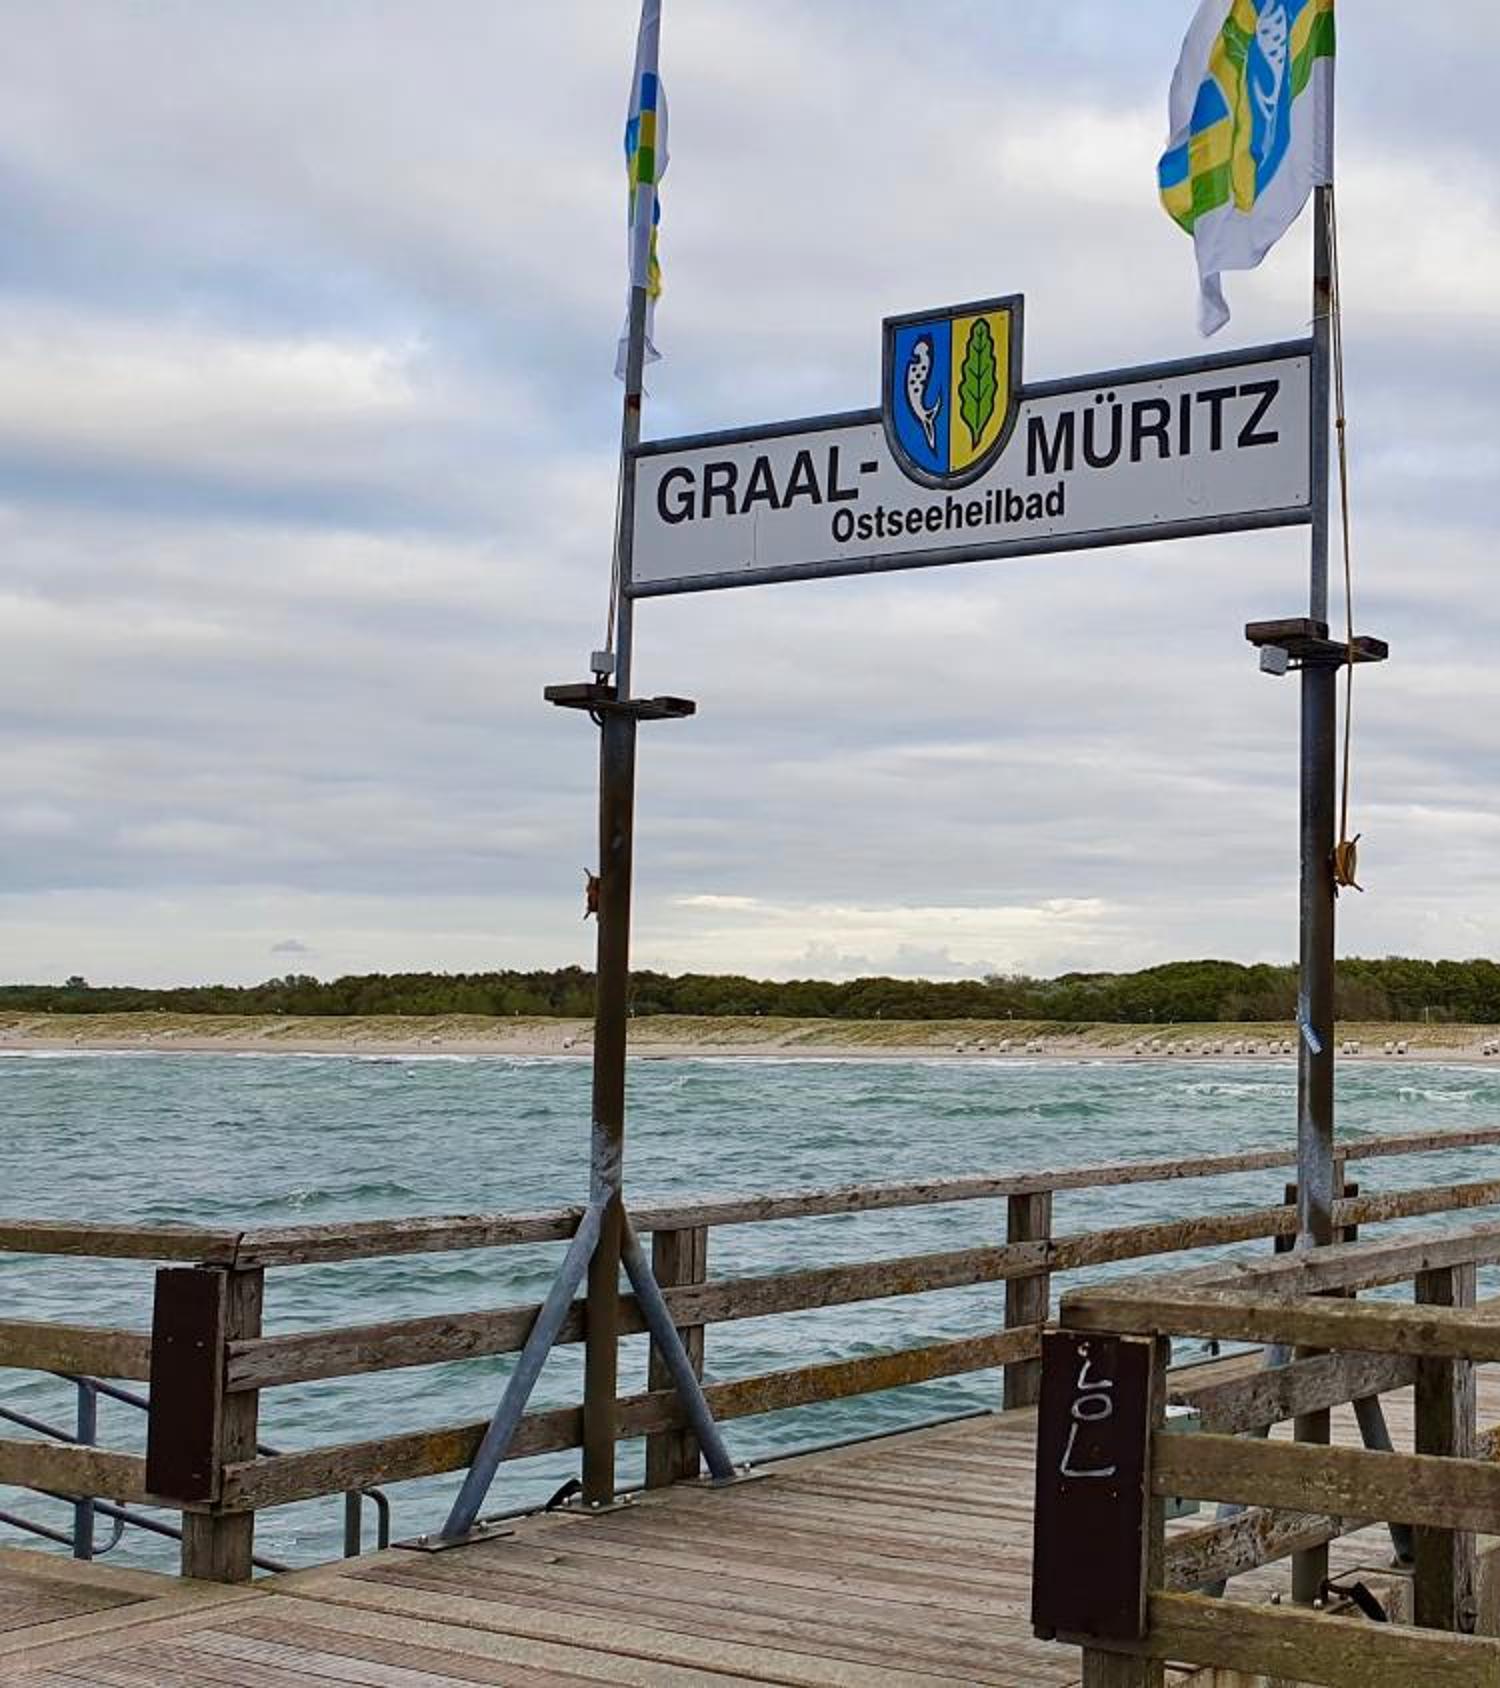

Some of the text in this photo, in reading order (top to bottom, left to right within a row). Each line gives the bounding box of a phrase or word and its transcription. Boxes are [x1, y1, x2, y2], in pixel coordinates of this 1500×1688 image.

[656, 379, 1281, 525] GRAAL- MÜRITZ
[831, 480, 1066, 543] Ostseeheilbad
